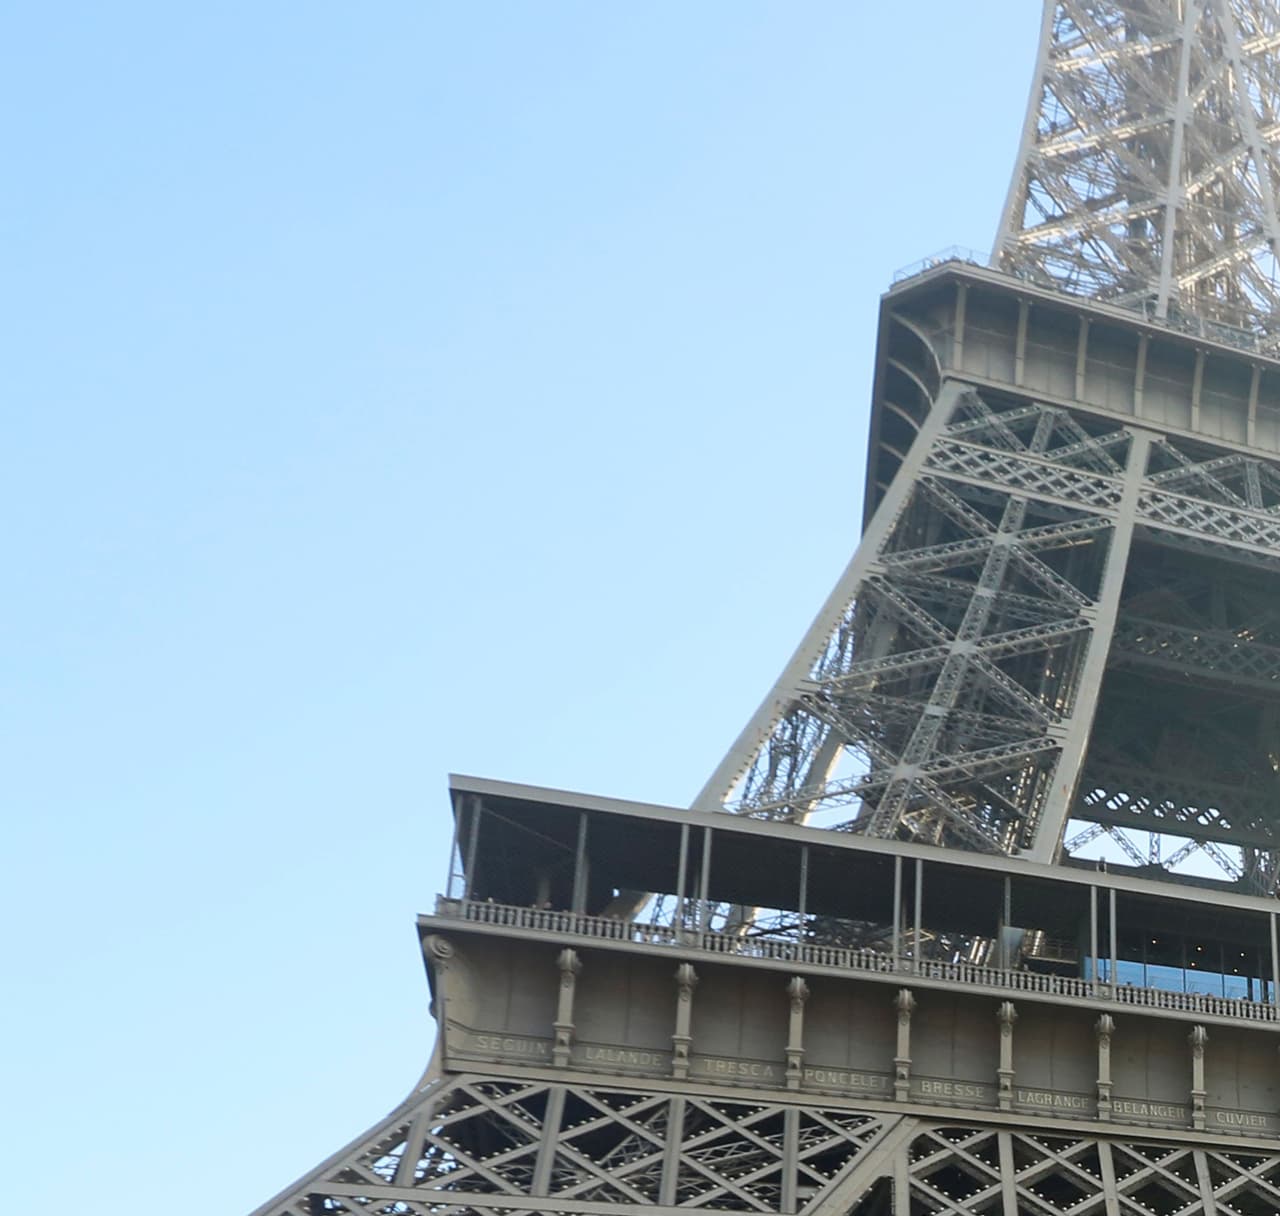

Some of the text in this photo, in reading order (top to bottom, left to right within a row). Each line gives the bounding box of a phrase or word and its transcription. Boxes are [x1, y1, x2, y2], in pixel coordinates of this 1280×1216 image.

[585, 1047, 663, 1067] LALANDE
[704, 1058, 774, 1077] TRESCA
[804, 1068, 889, 1089] PONCELET
[921, 1080, 985, 1098] BRESSE
[1017, 1091, 1089, 1109] LAGRANGE
[1113, 1102, 1185, 1119] BELANGER
[1216, 1111, 1267, 1127] CUVIER
